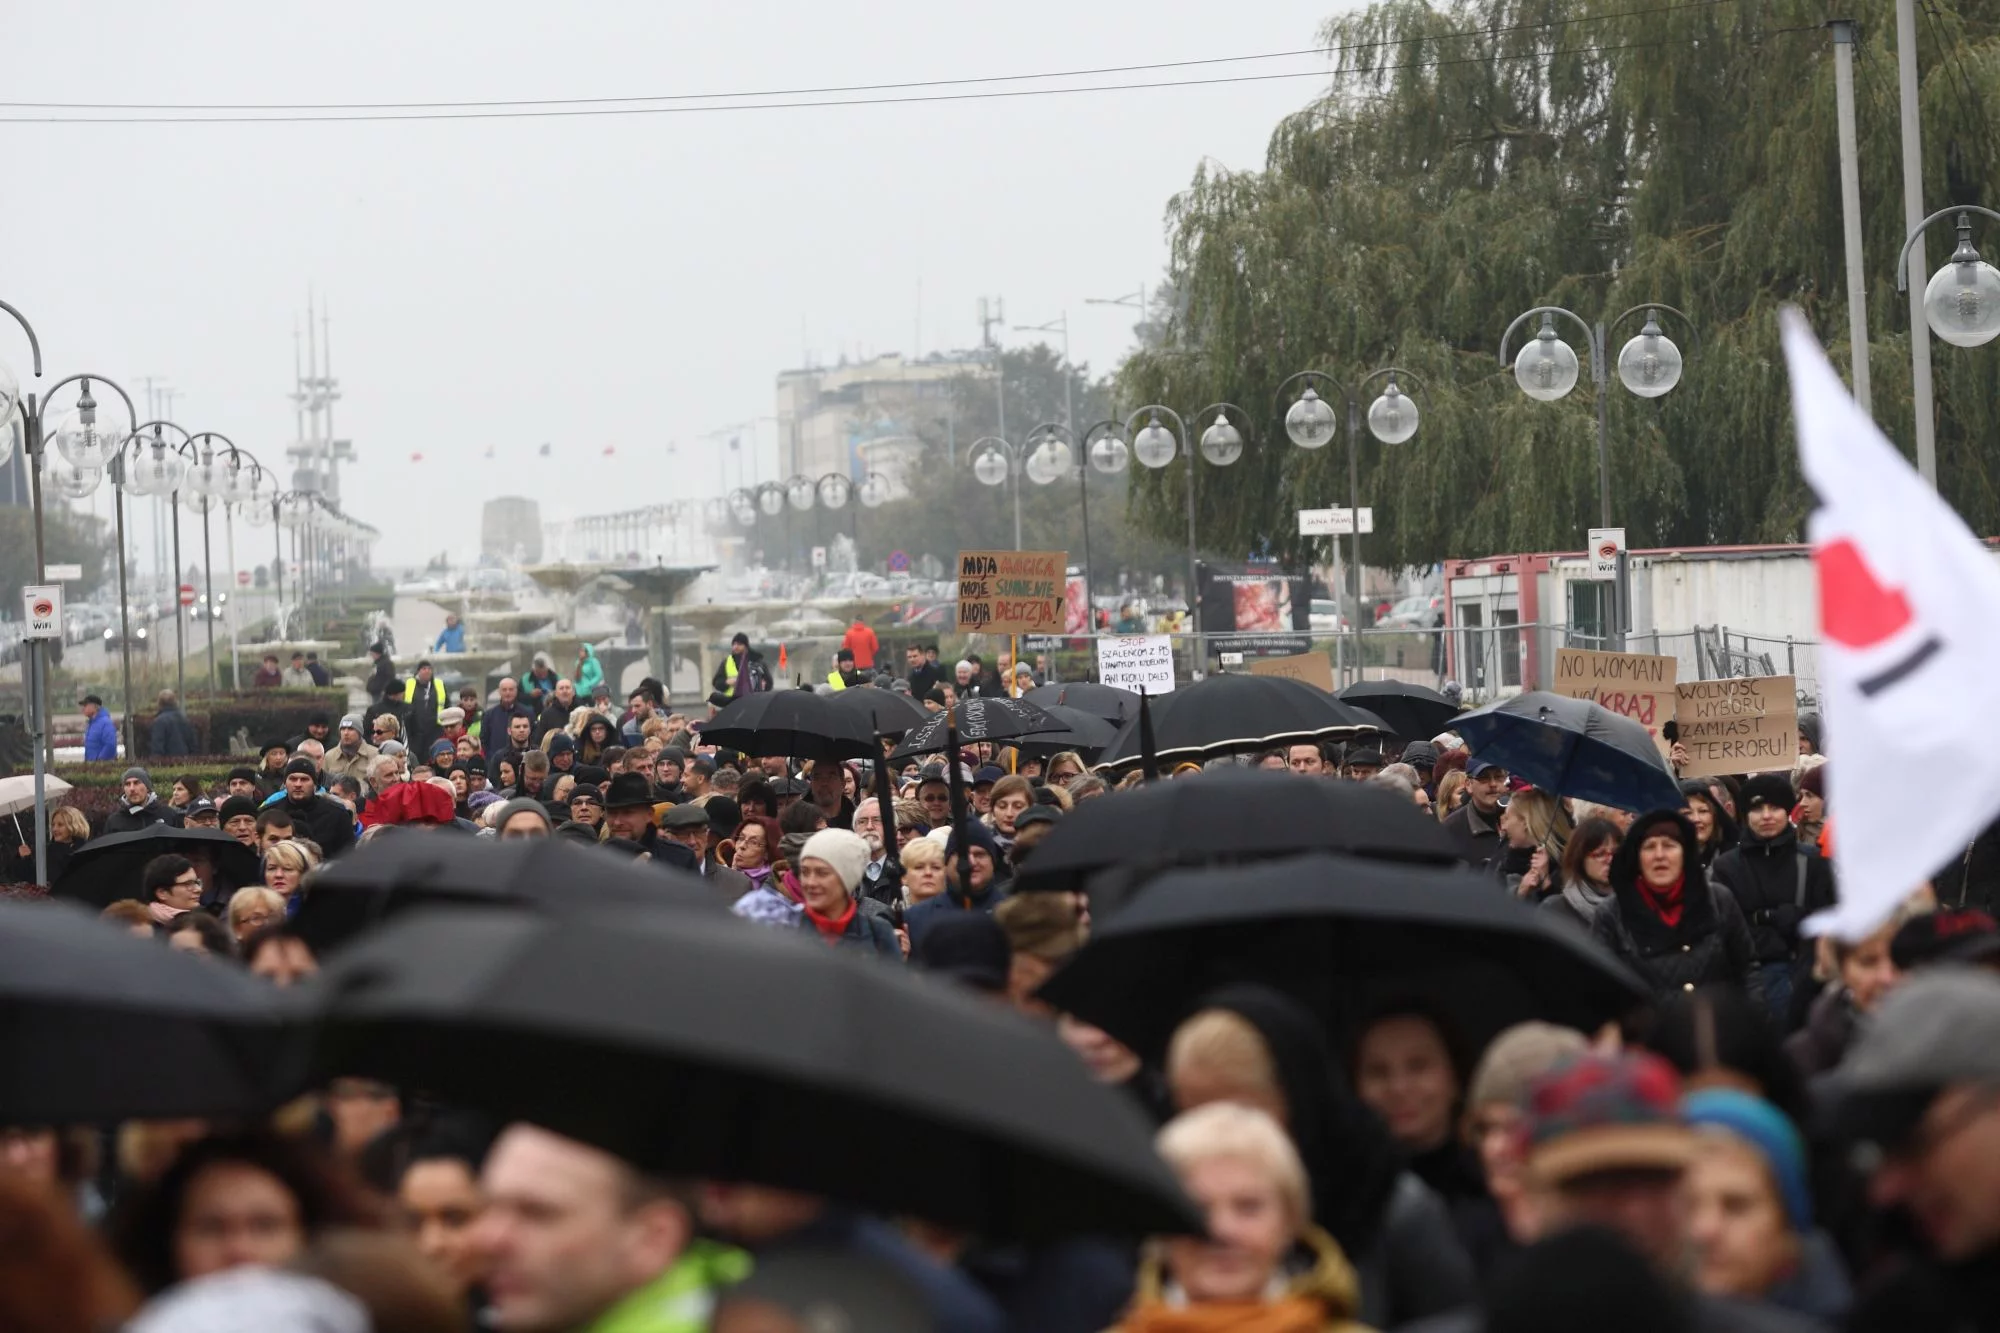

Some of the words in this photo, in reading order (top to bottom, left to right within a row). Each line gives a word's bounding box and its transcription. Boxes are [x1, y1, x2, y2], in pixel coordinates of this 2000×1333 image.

[963, 557, 997, 580] MOJA
[961, 581, 989, 599] MOJE
[33, 621, 52, 630] WiFi
[962, 602, 991, 629] MOJA
[1119, 637, 1146, 648] STOP
[1560, 655, 1585, 678] NO
[1592, 656, 1663, 682] WOMAN
[1697, 697, 1765, 718] WYBORU
[1681, 717, 1764, 738] ZAMIAST
[1693, 732, 1787, 760] TERRORU!
